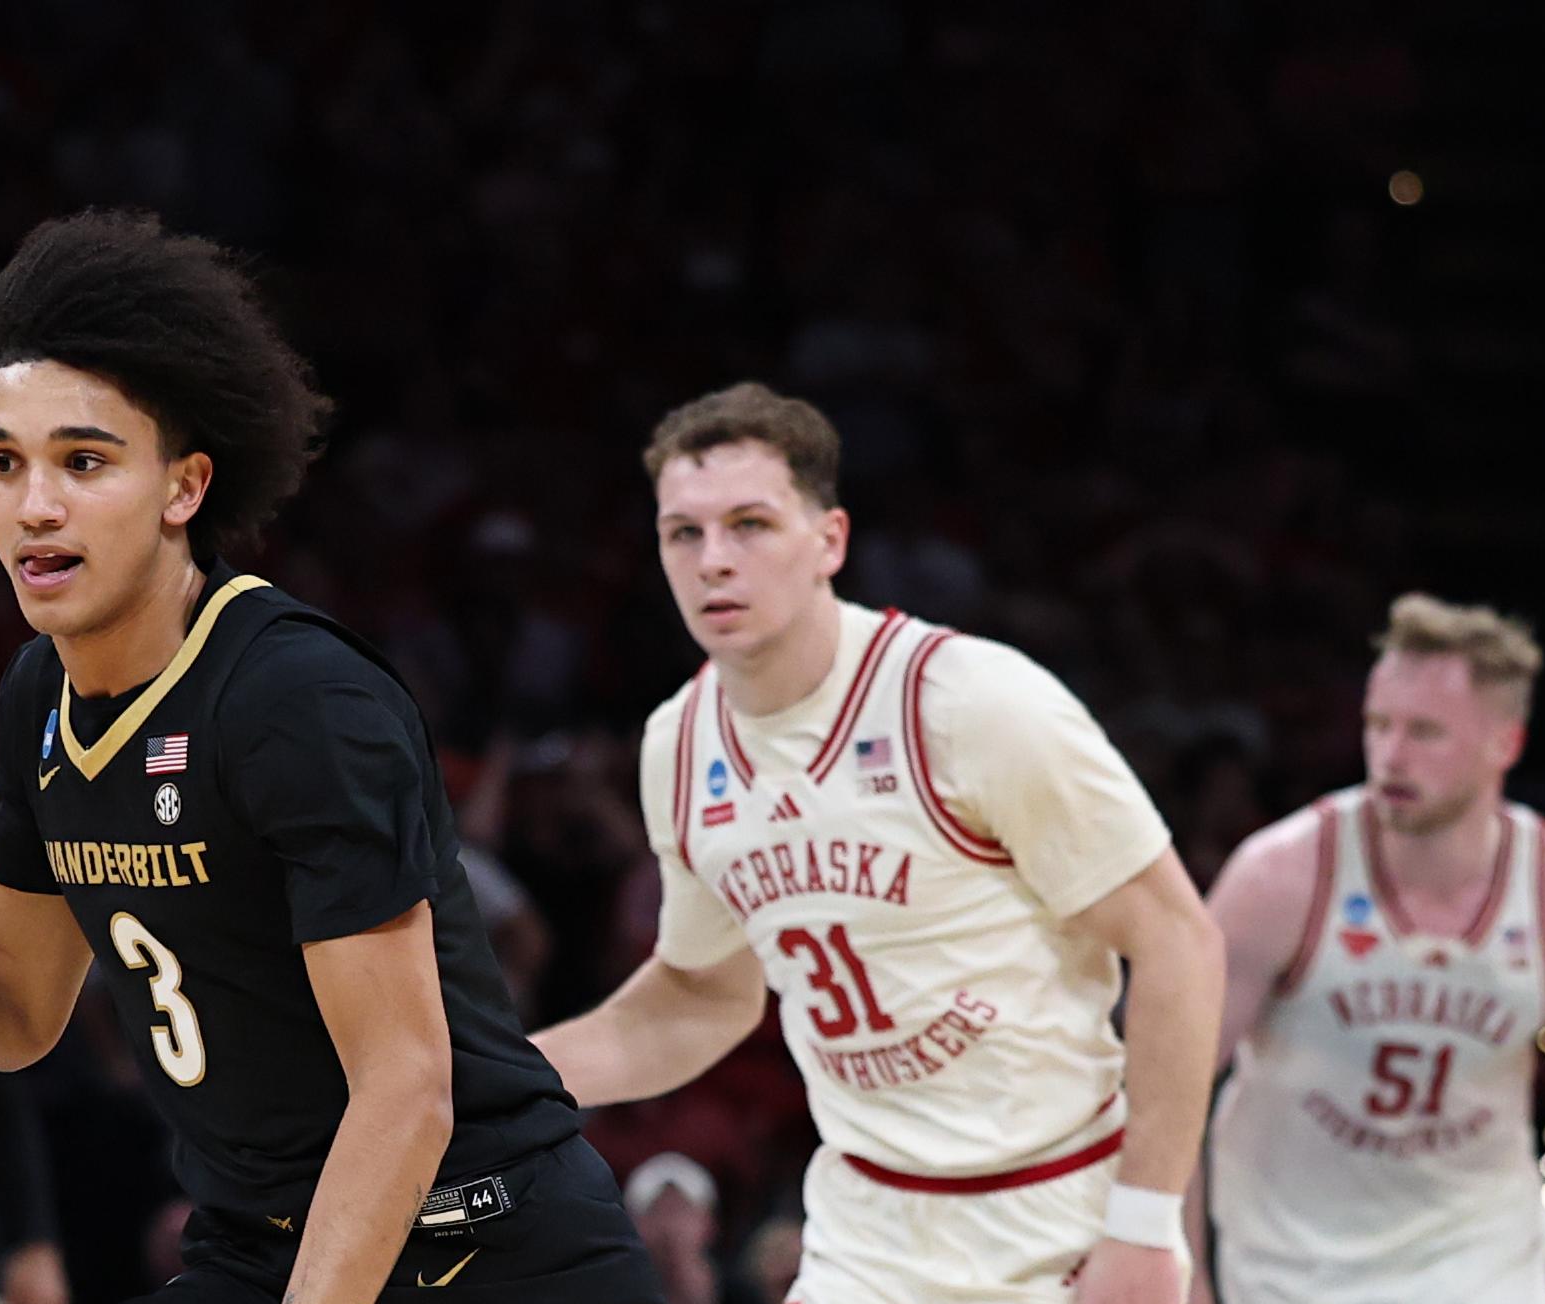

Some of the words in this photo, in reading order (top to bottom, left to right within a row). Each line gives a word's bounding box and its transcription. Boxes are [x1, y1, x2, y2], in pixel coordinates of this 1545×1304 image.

[156, 785, 180, 823] SEC
[718, 839, 912, 920] NEBRASKA
[111, 911, 206, 1088] 3
[777, 922, 895, 1039] 31
[1363, 1042, 1456, 1119] 51
[471, 1188, 494, 1209] 44
